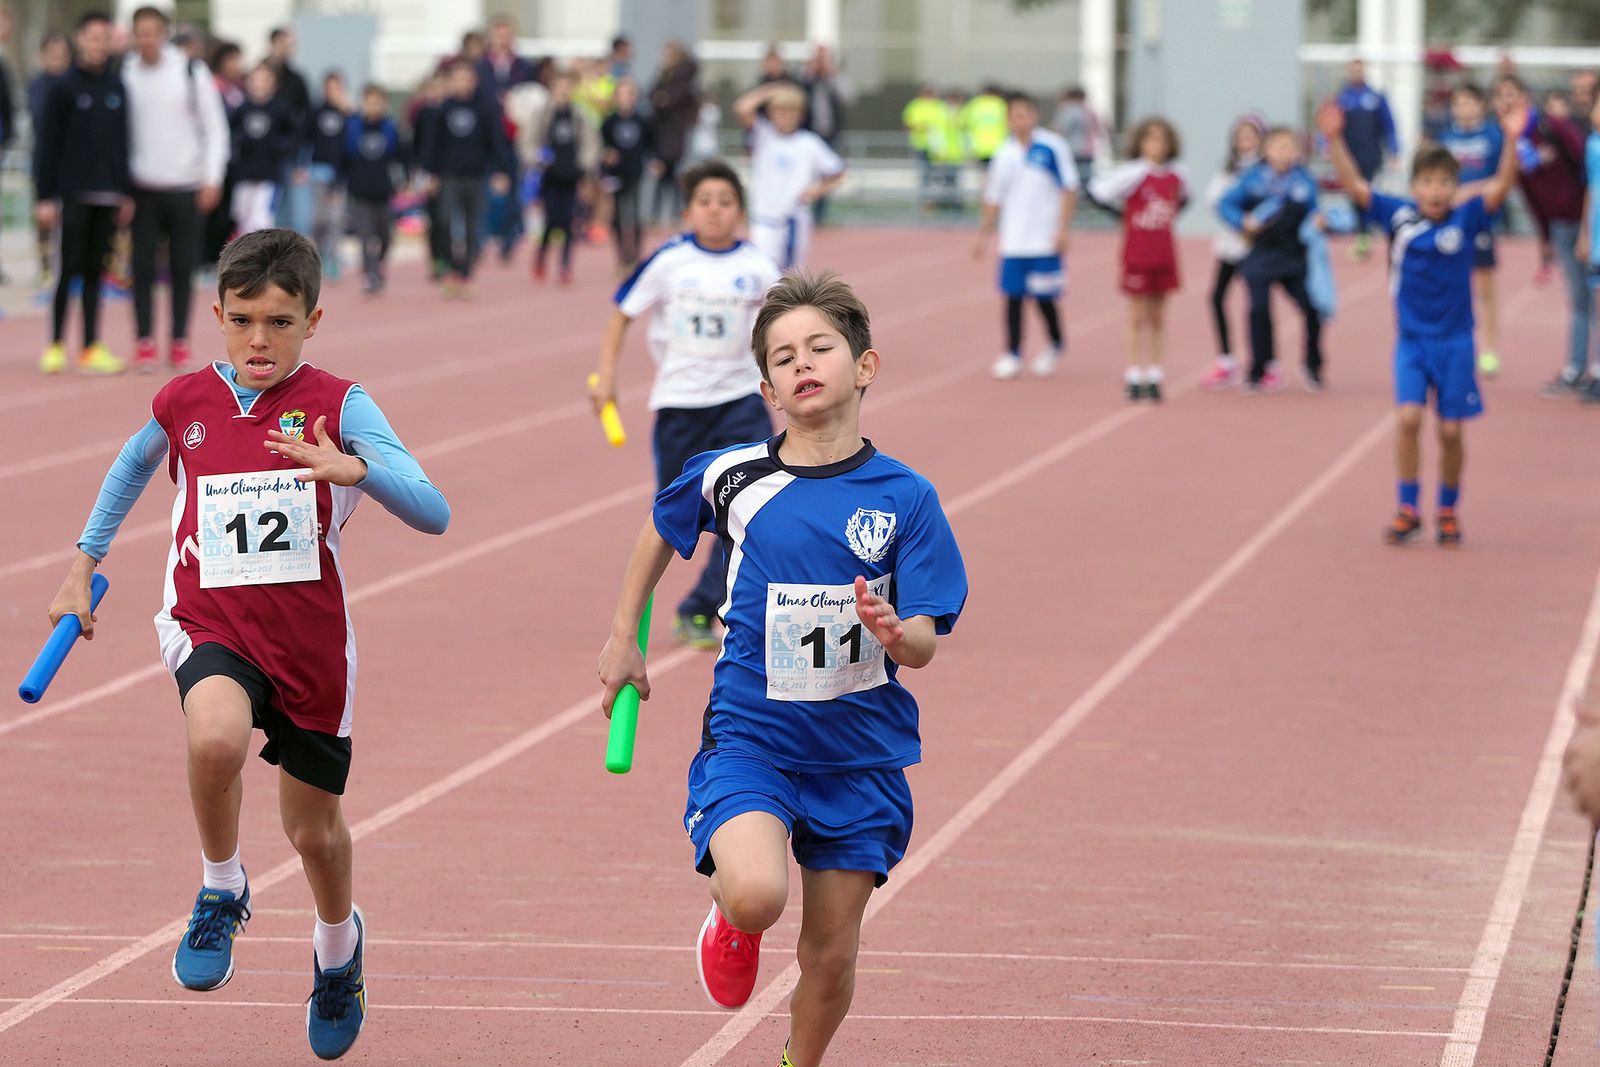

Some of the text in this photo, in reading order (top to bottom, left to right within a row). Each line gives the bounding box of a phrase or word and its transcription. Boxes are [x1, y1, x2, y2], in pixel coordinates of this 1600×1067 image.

[689, 313, 726, 339] 13
[206, 483, 229, 497] Unas
[230, 477, 292, 499] Olimpiadas
[225, 511, 290, 554] 12
[777, 592, 808, 606] Unas
[810, 591, 857, 613] Olimpia
[801, 623, 862, 668] 11
